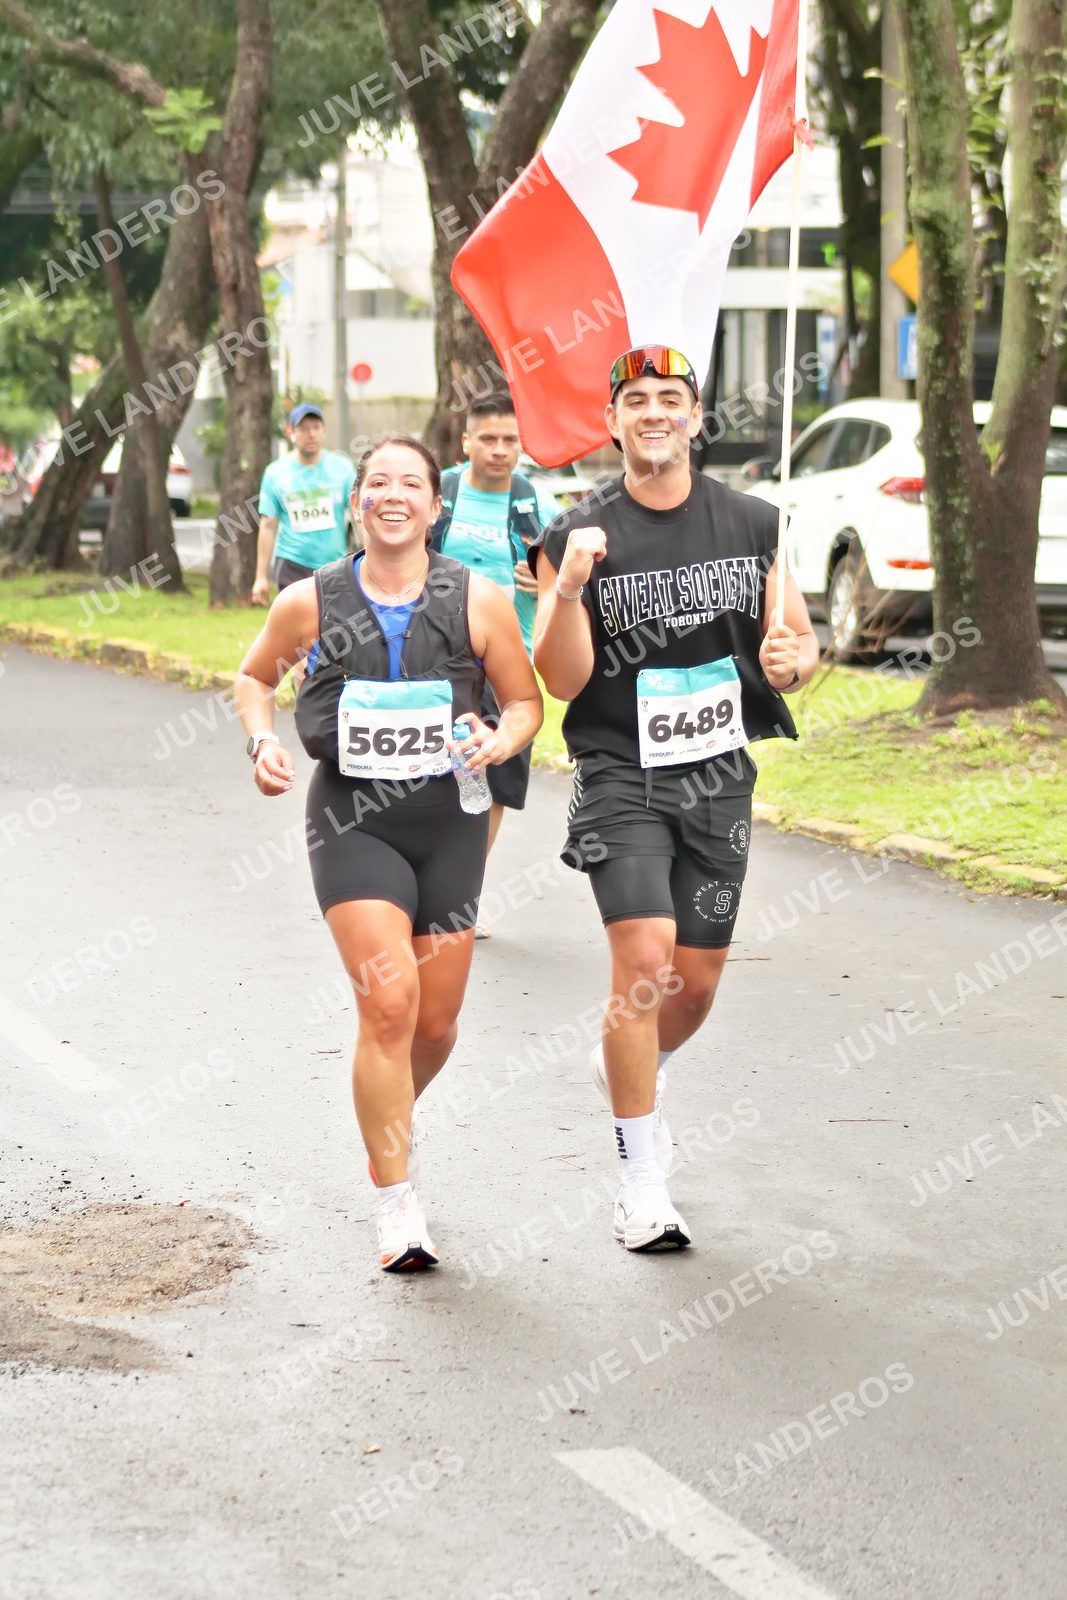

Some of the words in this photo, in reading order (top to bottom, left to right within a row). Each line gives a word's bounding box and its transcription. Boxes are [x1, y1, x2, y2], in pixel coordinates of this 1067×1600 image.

[599, 570, 675, 637] SWEAT
[676, 556, 760, 619] SOCIETY
[664, 610, 714, 628] TORONTO
[648, 699, 734, 743] 6489
[346, 724, 445, 756] 5625
[693, 881, 719, 902] SWEAT
[713, 890, 732, 914] S
